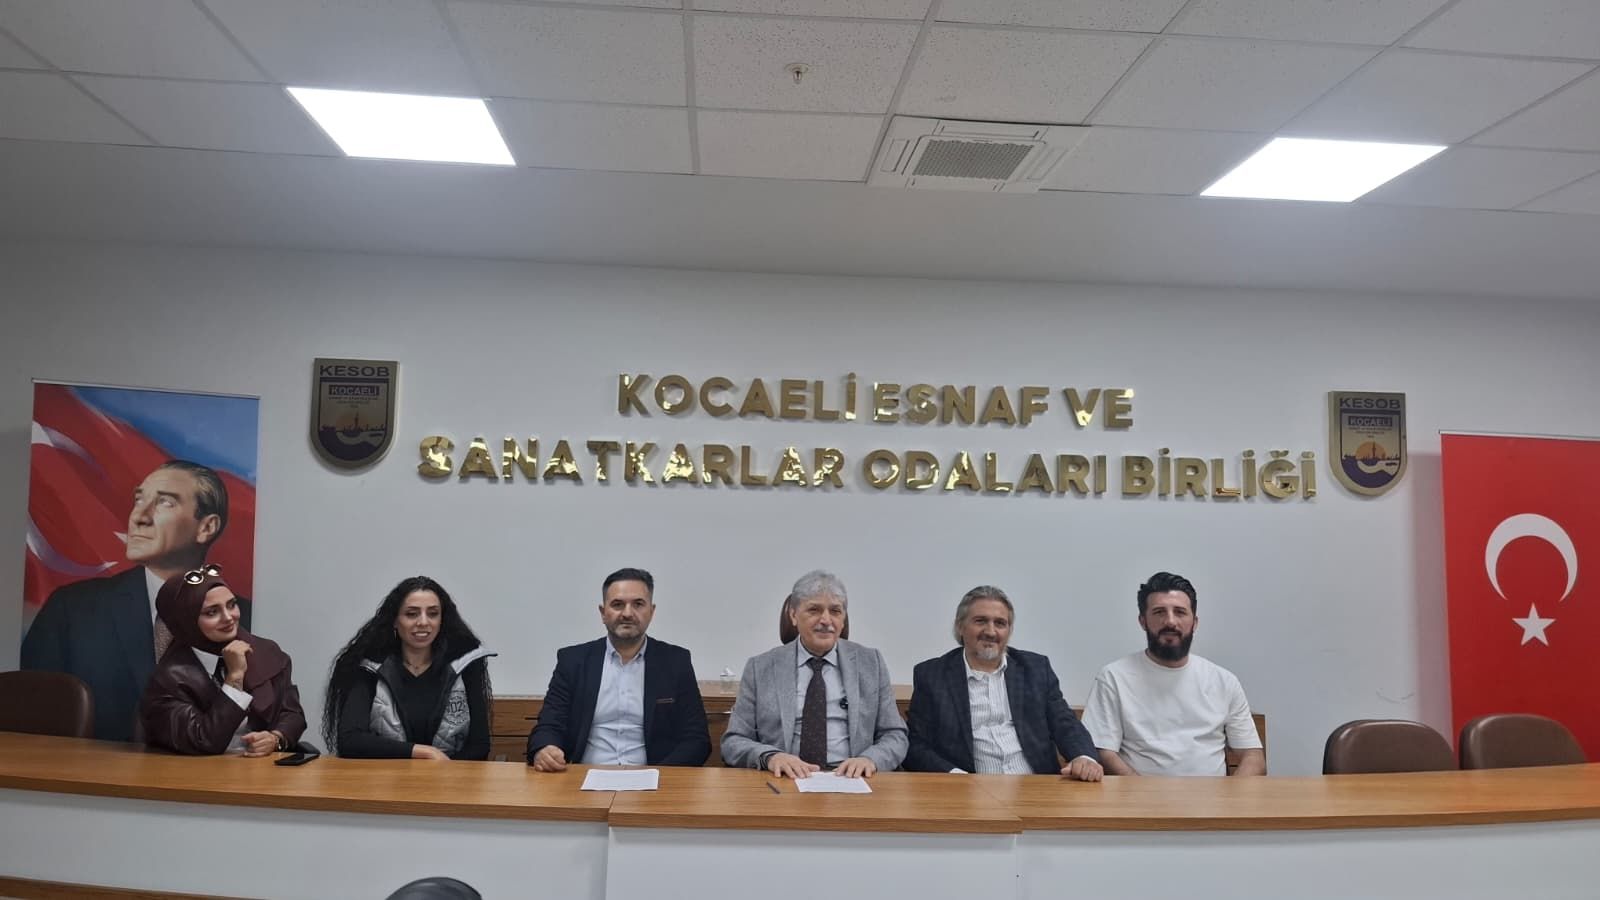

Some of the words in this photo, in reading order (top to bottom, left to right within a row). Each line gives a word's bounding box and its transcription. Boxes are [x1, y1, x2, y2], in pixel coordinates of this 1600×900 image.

[320, 365, 390, 377] KESOB
[617, 372, 858, 420] KOCAELİ
[873, 382, 1050, 426] ESNAF
[1063, 387, 1135, 428] VE
[1340, 397, 1401, 410] KESOB
[417, 435, 846, 488] SANATKARLAR
[863, 448, 1107, 494] ODALARI
[1121, 447, 1317, 499] BİRLİĞİ
